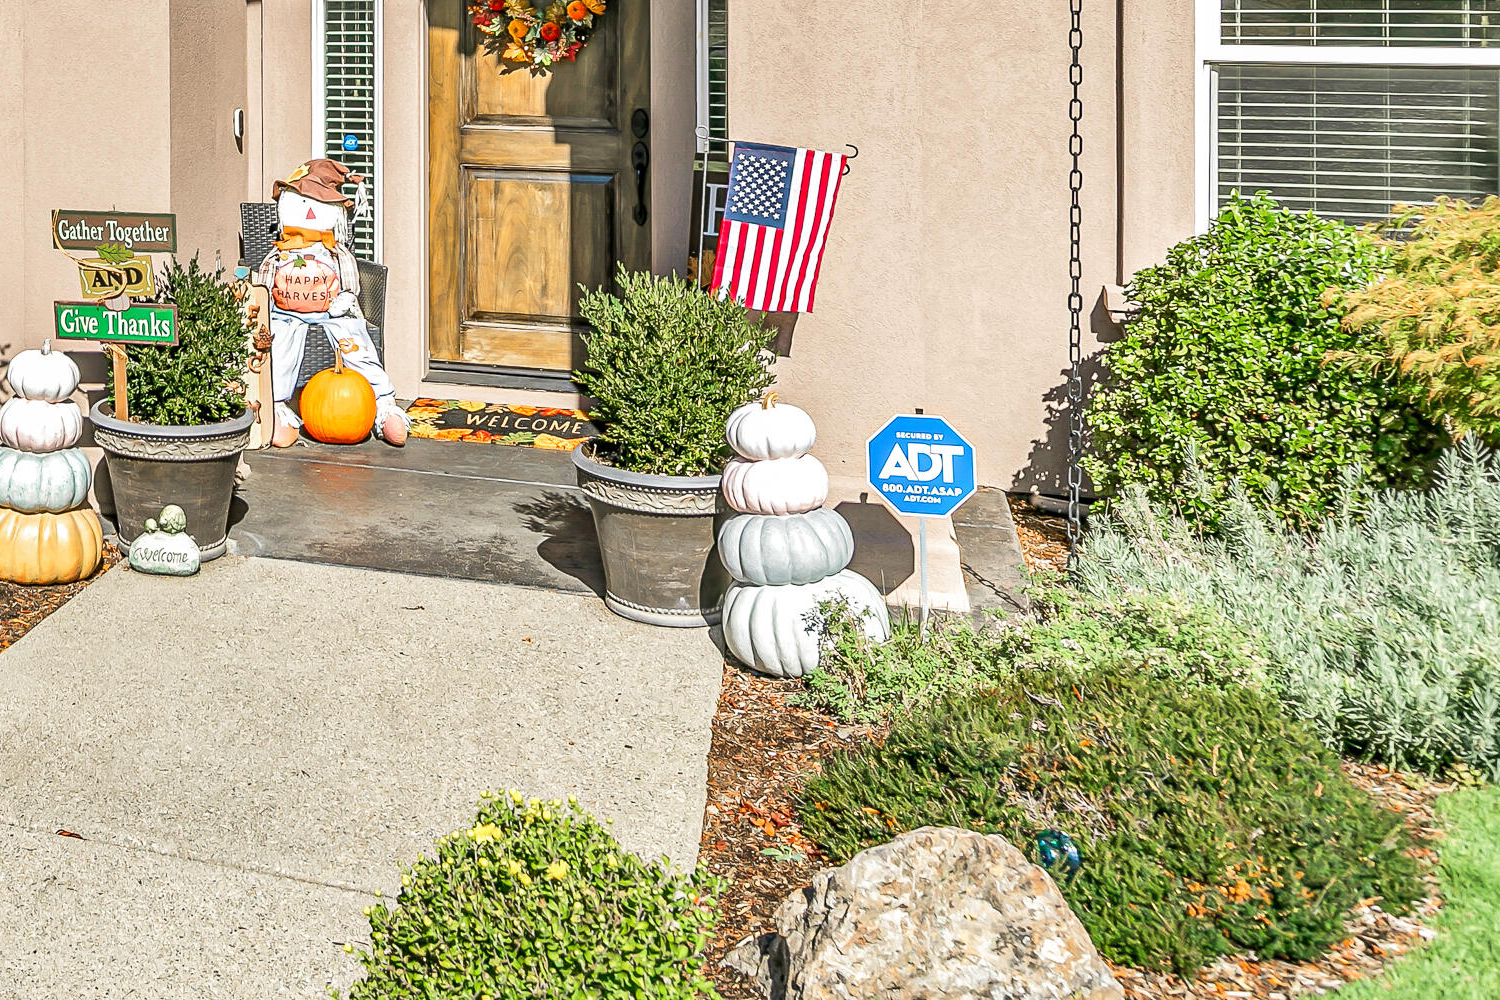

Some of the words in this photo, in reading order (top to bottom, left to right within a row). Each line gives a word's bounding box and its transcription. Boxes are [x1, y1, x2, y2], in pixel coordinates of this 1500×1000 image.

[58, 219, 104, 241] Gather
[105, 220, 169, 248] Together
[92, 267, 144, 288] AND
[285, 274, 328, 285] HAPPY
[277, 289, 332, 302] HARVEST
[60, 309, 99, 334] Give
[102, 311, 171, 337] Thanks
[466, 413, 583, 434] WELCOME
[896, 431, 932, 440] SECURED
[933, 433, 944, 441] BY
[878, 442, 965, 484] ADT
[882, 483, 963, 497] 800.ADT.ASAP
[903, 495, 942, 504] ADT.COM
[133, 547, 189, 563] Welcome
